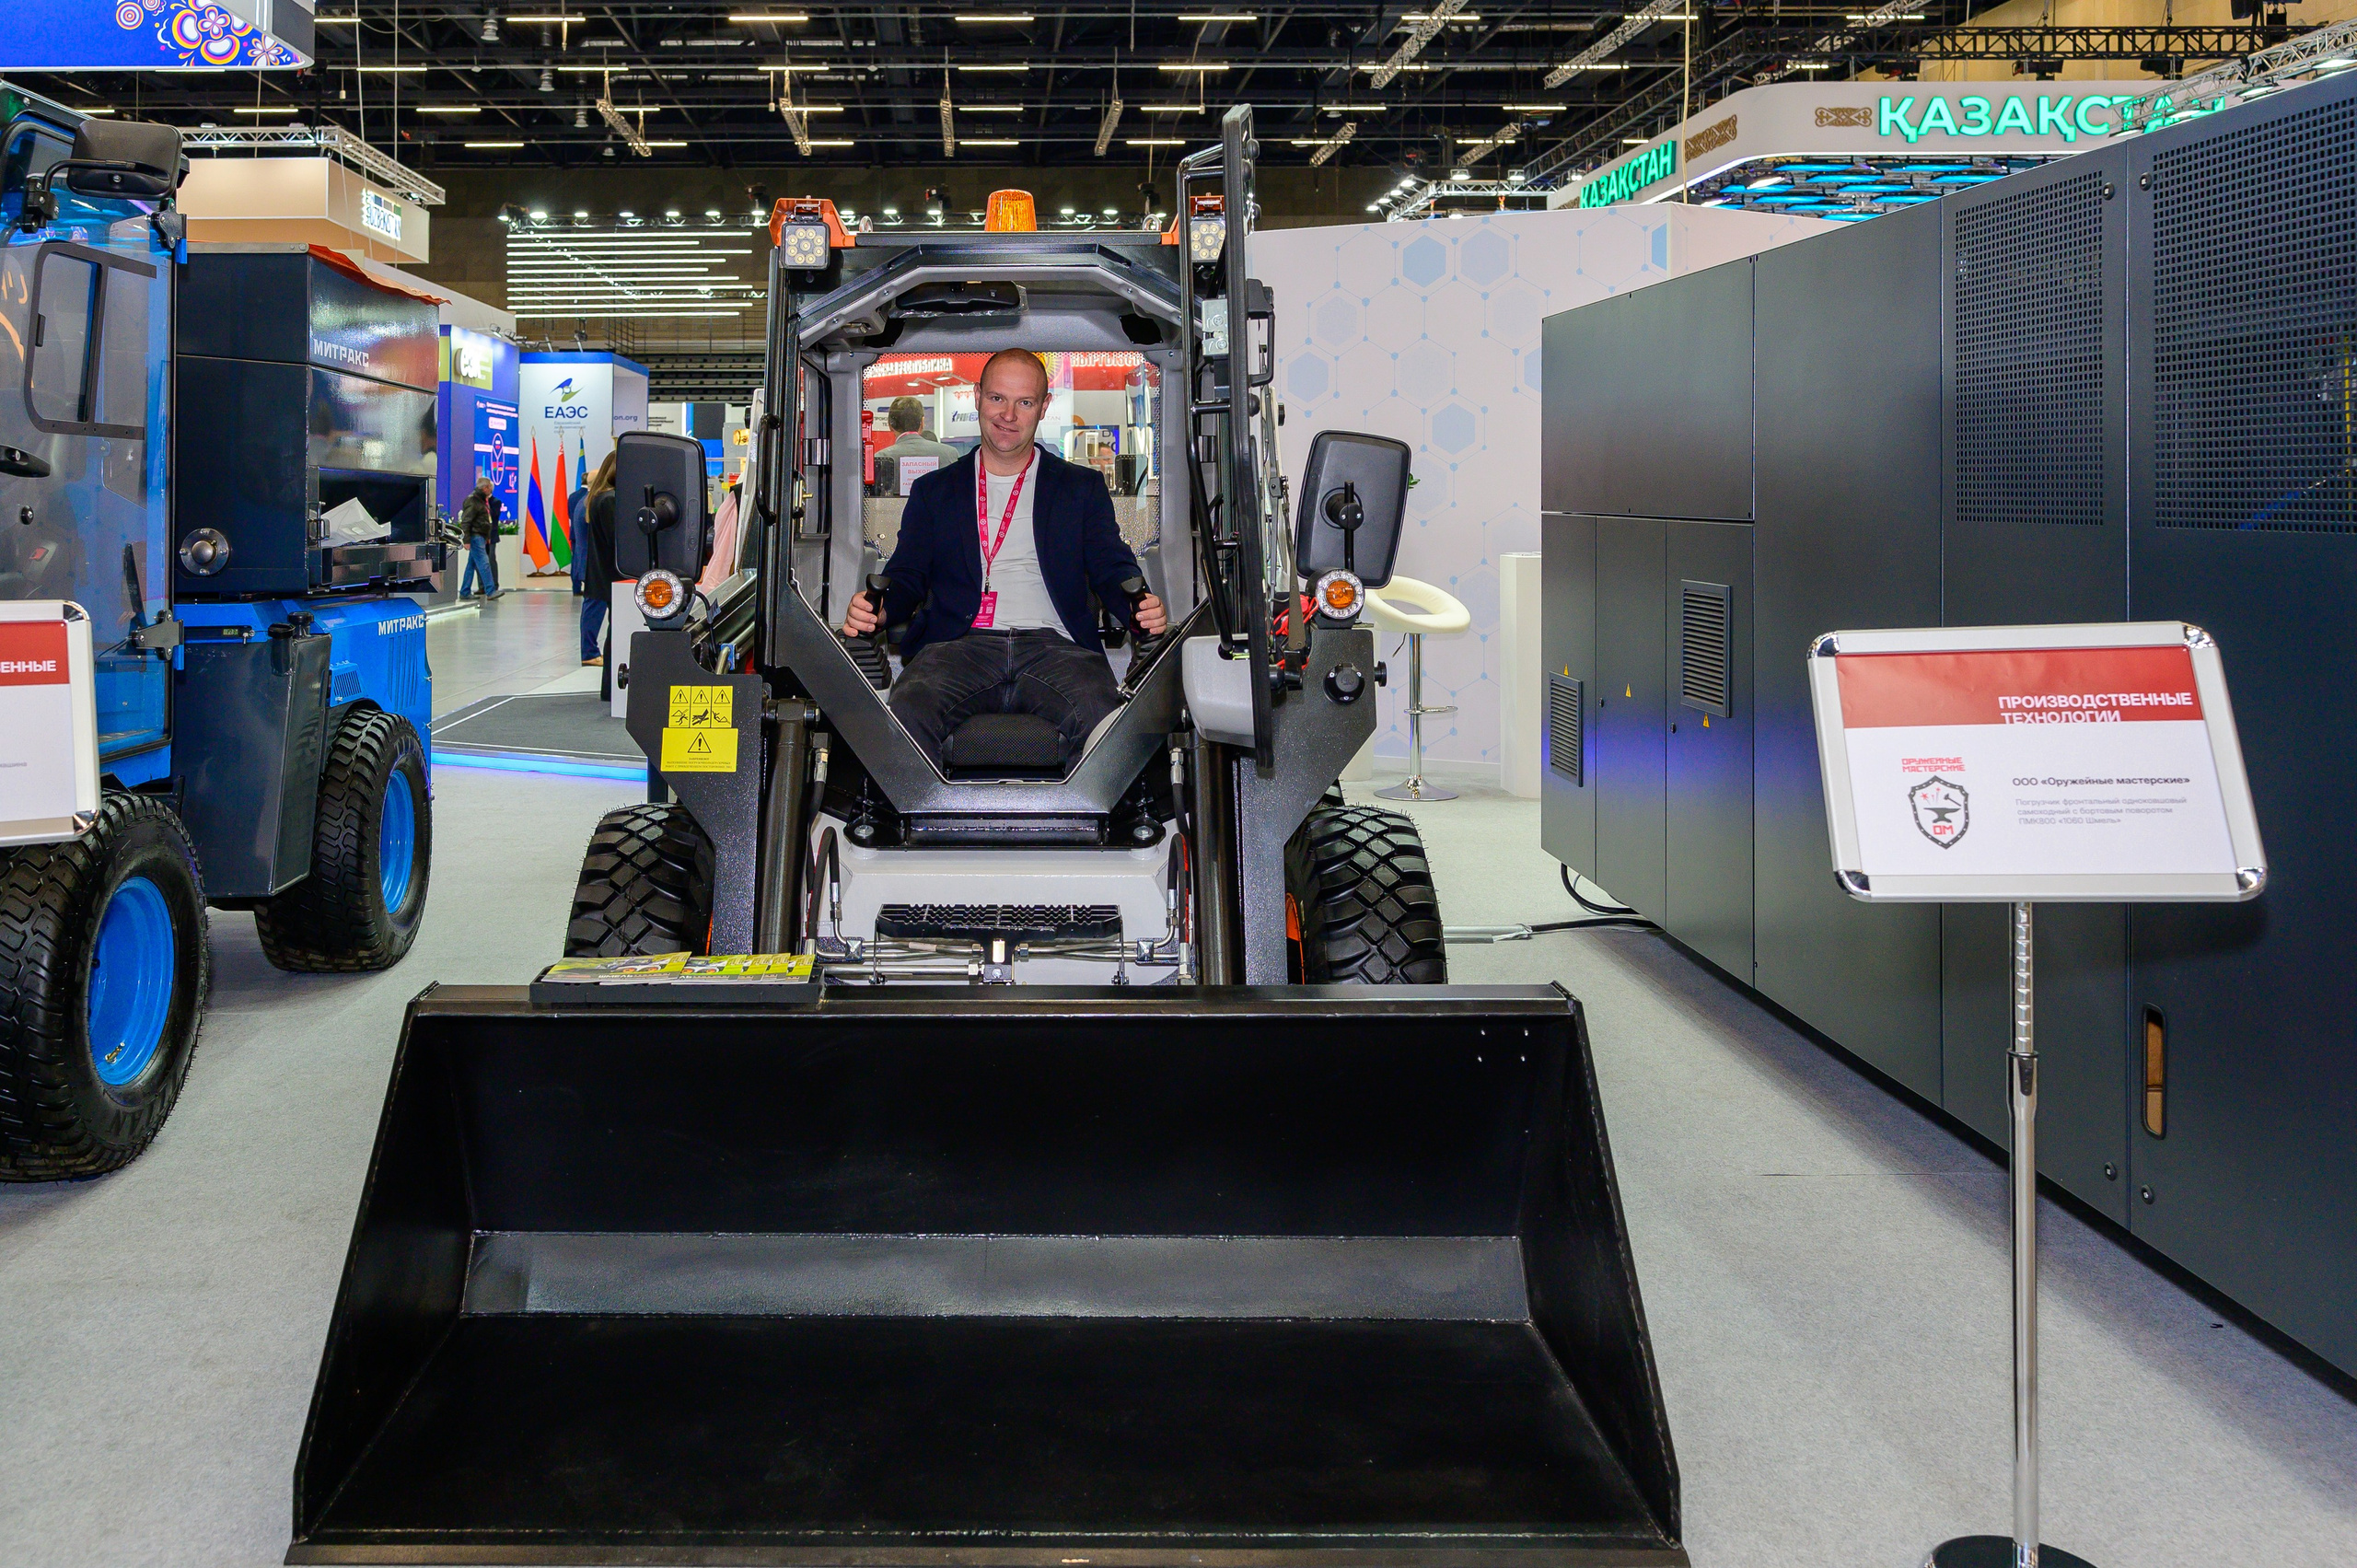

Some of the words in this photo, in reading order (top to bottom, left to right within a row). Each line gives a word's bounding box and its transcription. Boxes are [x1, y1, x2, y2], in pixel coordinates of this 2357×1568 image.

[313, 339, 369, 368] МИТРАКС
[544, 406, 588, 419] ЕАЭС
[377, 614, 424, 636] МИТРАКС
[0, 660, 57, 673] ЕННЫЕ
[1998, 692, 2193, 709] ПРОИЗВОДСТВЕННЫЕ
[2001, 710, 2121, 724] ТЕХНОЛОГИИ
[1902, 764, 1966, 772] МАСТЕРСКИЕ
[2012, 777, 2038, 786] ООО
[2040, 776, 2114, 787] «Оружейные
[2116, 776, 2190, 785] мастерские»
[2015, 798, 2060, 807] Погрузчик
[2062, 797, 2120, 807] фронтальный
[2017, 807, 2071, 816] самоходный
[2079, 807, 2123, 816] бортовым
[1933, 825, 1955, 835] ОМ
